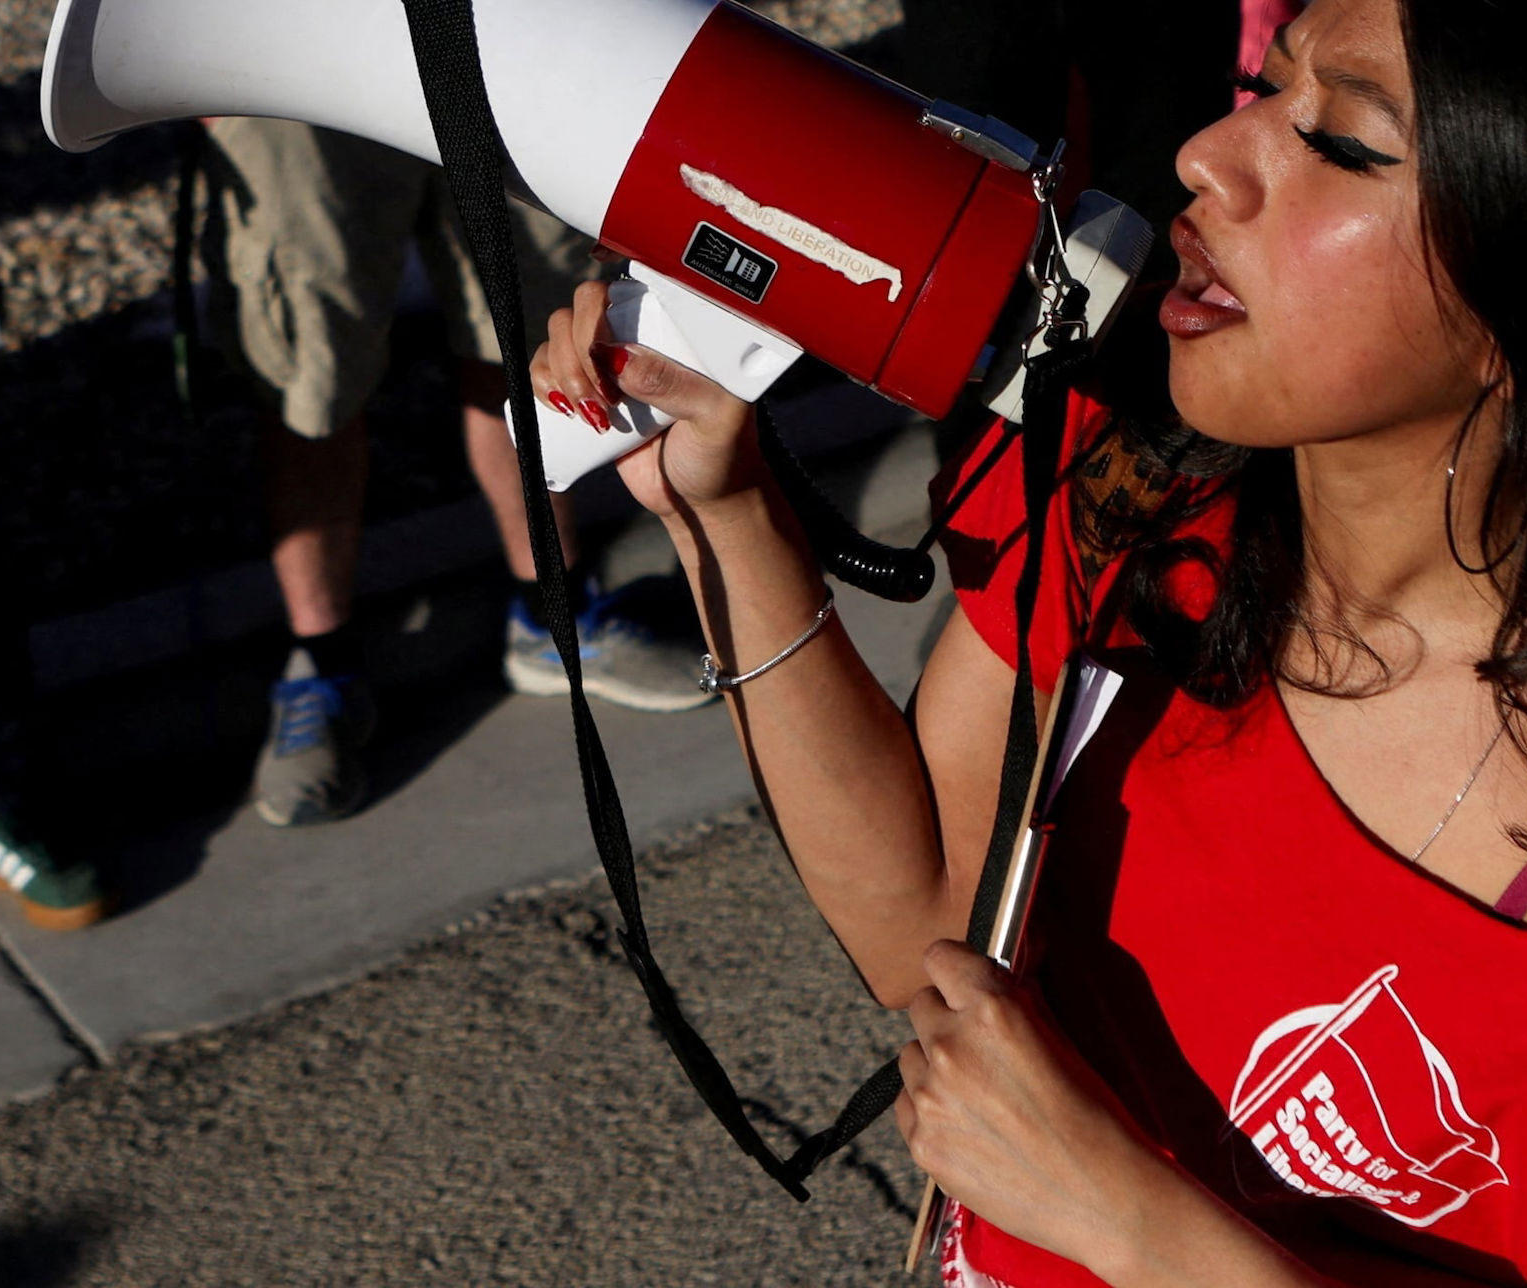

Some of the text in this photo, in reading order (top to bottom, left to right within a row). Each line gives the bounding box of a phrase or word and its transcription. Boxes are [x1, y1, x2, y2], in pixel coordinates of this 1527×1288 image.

[689, 258, 733, 285] AUTOMATIC
[777, 221, 876, 280] LIBERATION
[1300, 1070, 1399, 1182] Party for
